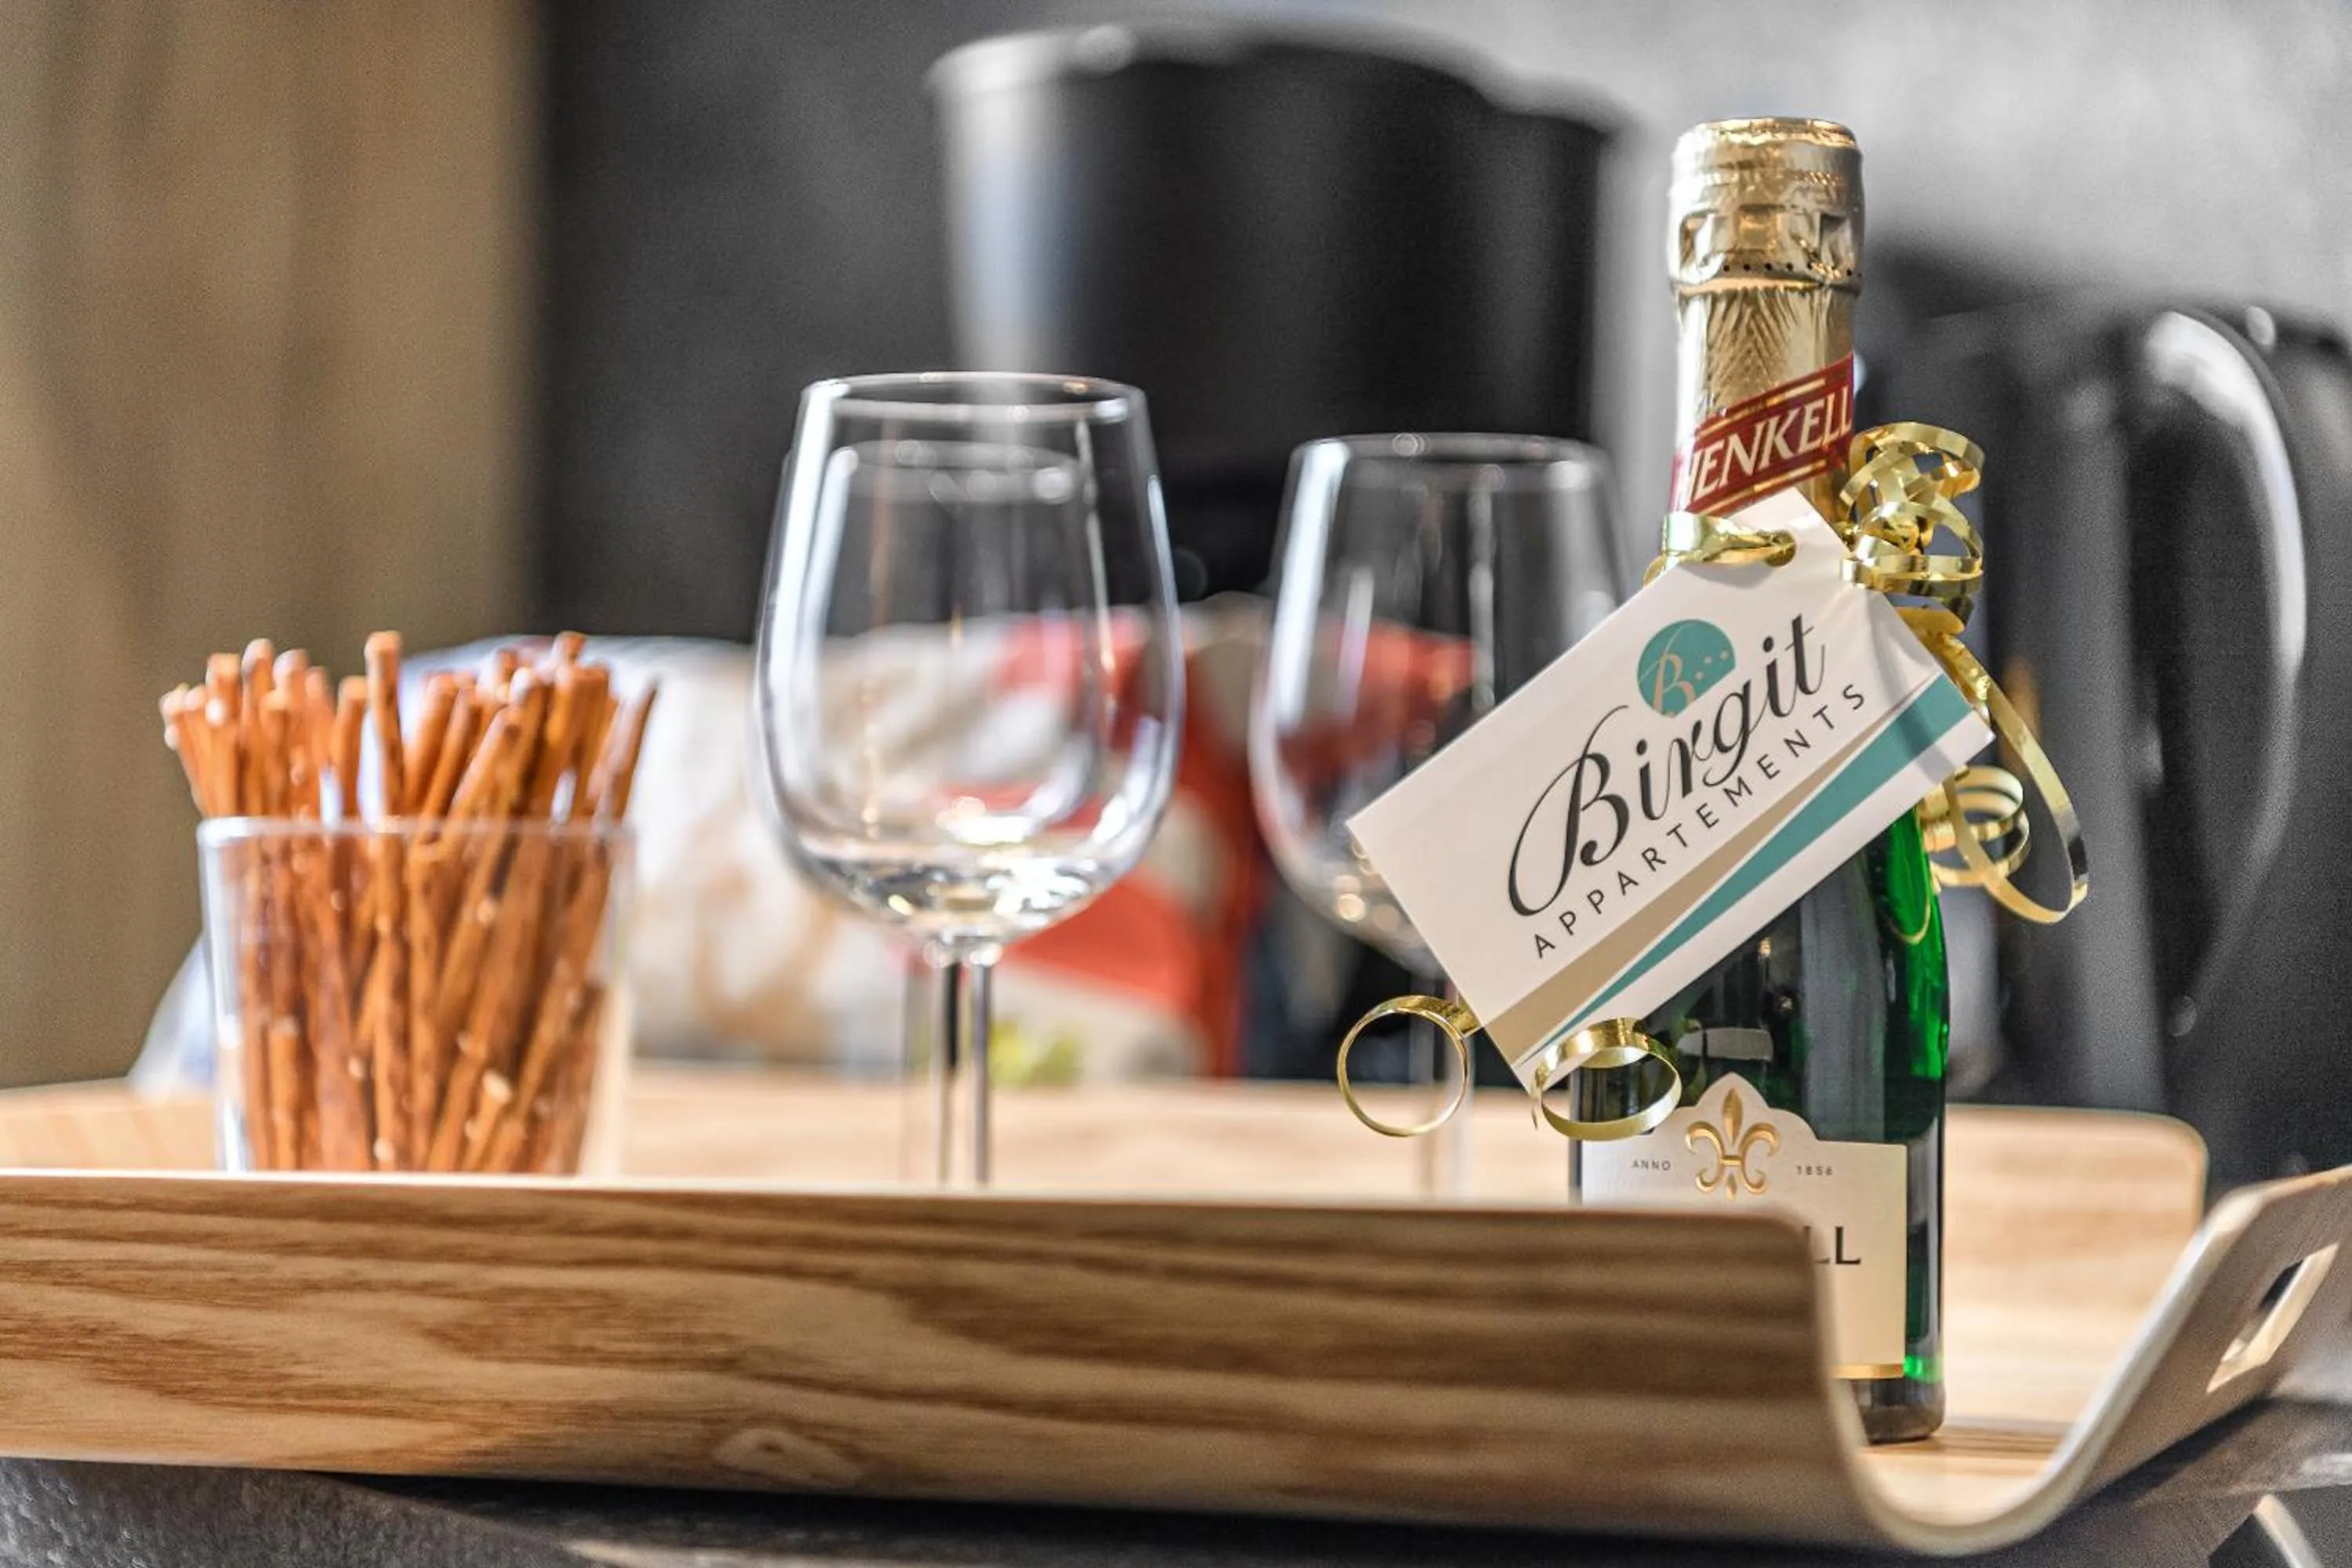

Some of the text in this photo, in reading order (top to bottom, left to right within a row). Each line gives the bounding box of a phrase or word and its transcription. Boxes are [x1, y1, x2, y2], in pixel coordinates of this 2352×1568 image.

[1508, 614, 1826, 917] Birgit
[1534, 683, 1865, 958] APPARTEMENTS
[1632, 1159, 1671, 1171] ANNO
